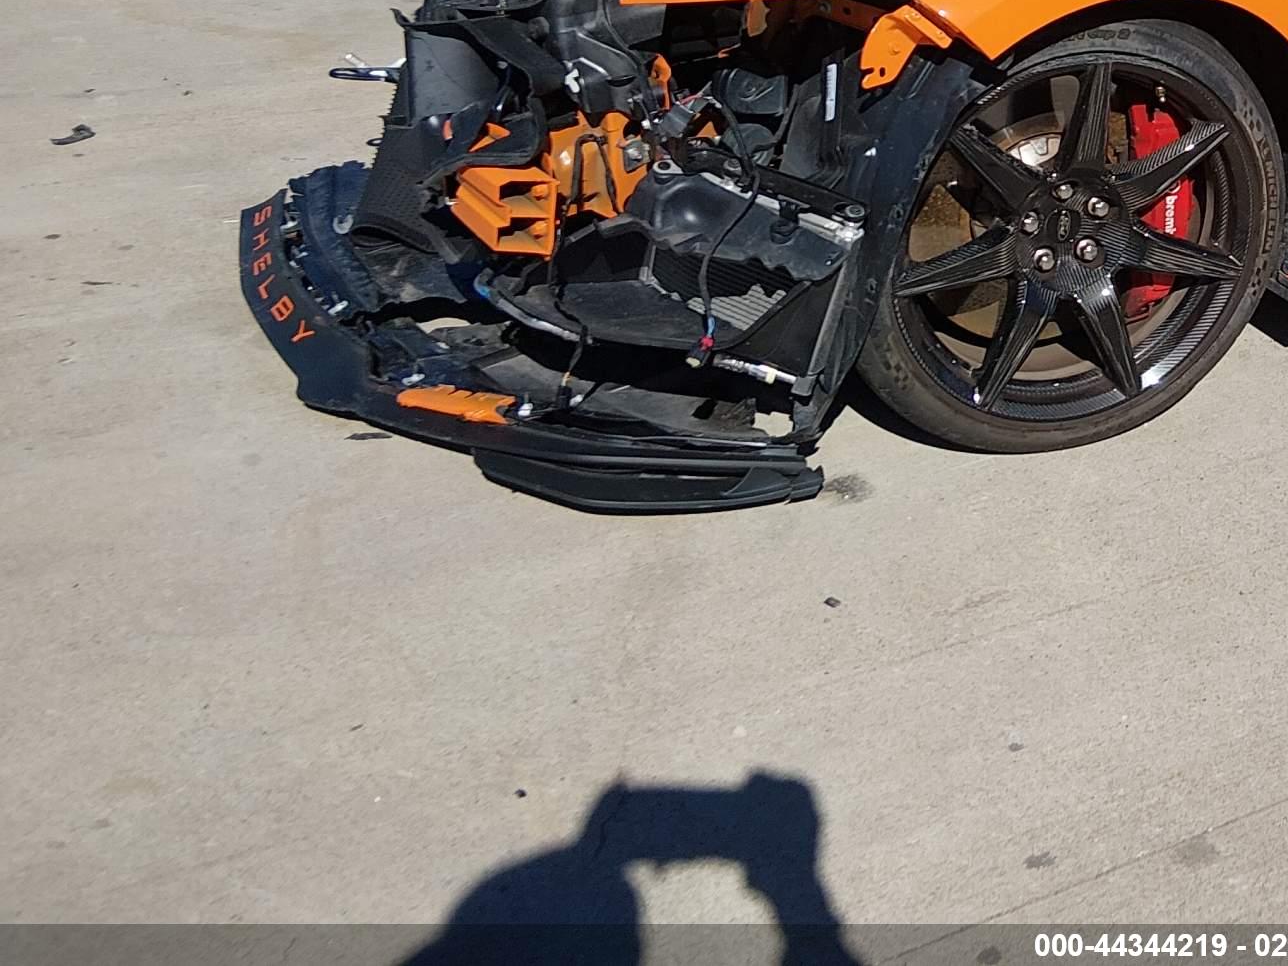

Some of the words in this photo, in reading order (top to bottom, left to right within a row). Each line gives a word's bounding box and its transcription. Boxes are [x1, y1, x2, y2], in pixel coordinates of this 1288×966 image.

[1164, 195, 1178, 235] bremb
[1263, 161, 1277, 252] MICHELIN
[252, 205, 316, 343] SHELBY
